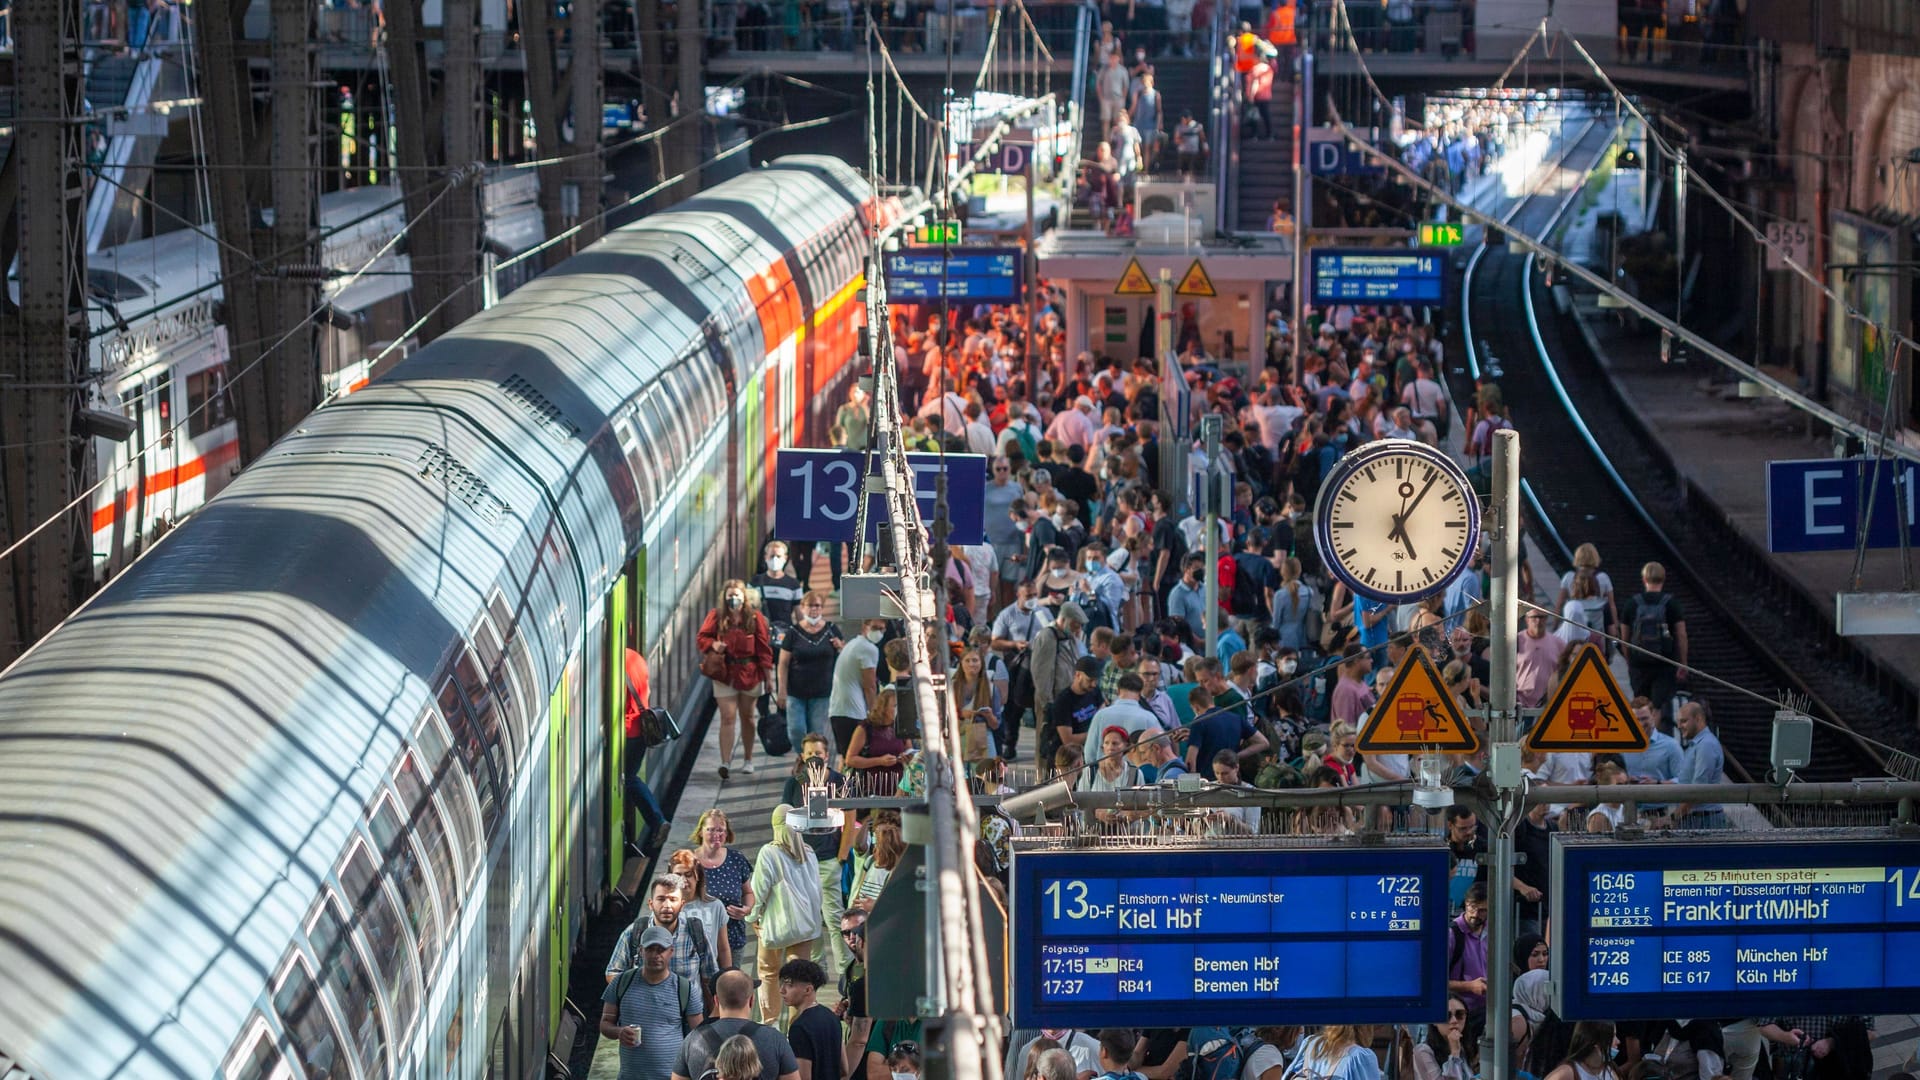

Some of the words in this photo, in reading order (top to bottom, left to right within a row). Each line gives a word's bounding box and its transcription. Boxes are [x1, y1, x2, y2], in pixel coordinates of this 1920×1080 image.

[1004, 145, 1023, 171] D
[1320, 144, 1338, 170] D
[890, 256, 906, 271] 13
[1418, 256, 1432, 273] 14
[790, 460, 858, 521] 13
[1804, 470, 1845, 534] E
[1377, 876, 1420, 894] 17:22
[1592, 874, 1635, 890] 16:46
[1682, 873, 1700, 882] ca.
[1704, 872, 1717, 882] 25
[1720, 871, 1772, 881] Minuten
[1118, 894, 1168, 904] Elmshorn
[1180, 893, 1210, 904] Wrist
[1220, 892, 1284, 903] Neumünster
[1591, 893, 1600, 904] IC
[1603, 892, 1629, 904] 2215
[1664, 886, 1702, 897] Bremen
[1704, 886, 1722, 896] Hbf
[1733, 885, 1790, 896] Düsseldorf
[1794, 884, 1812, 895] Hbf
[1822, 884, 1846, 894] Köln
[1848, 884, 1866, 894] Hbf
[1044, 880, 1088, 920] 13
[1089, 904, 1115, 919] D-F
[1394, 896, 1420, 906] RE70
[1350, 911, 1357, 919] C
[1360, 911, 1367, 919] D
[1370, 911, 1376, 919] E
[1664, 898, 1830, 921] Frankfurt(M)Hbf
[1118, 908, 1157, 929] Kiel
[1166, 908, 1202, 928] Hbf
[1042, 945, 1090, 954] Folgezüge
[1589, 938, 1636, 947] Folgezüge
[1044, 959, 1084, 974] 17:15
[1118, 959, 1144, 972] RE4
[1194, 957, 1248, 972] Bremen
[1254, 956, 1280, 971] Hbf
[1590, 951, 1630, 966] 17:28
[1663, 951, 1683, 964] ICE
[1687, 950, 1711, 963] 885
[1736, 948, 1798, 963] München
[1803, 948, 1828, 962] Hbf
[1044, 980, 1084, 994] 17:37
[1118, 980, 1152, 992] RB41
[1194, 978, 1248, 992] Bremen
[1254, 977, 1280, 992] Hbf
[1590, 972, 1630, 986] 17:46
[1663, 972, 1683, 984] ICE
[1686, 971, 1711, 984] 617
[1736, 969, 1768, 984] Köln
[1774, 968, 1798, 982] Hbf
